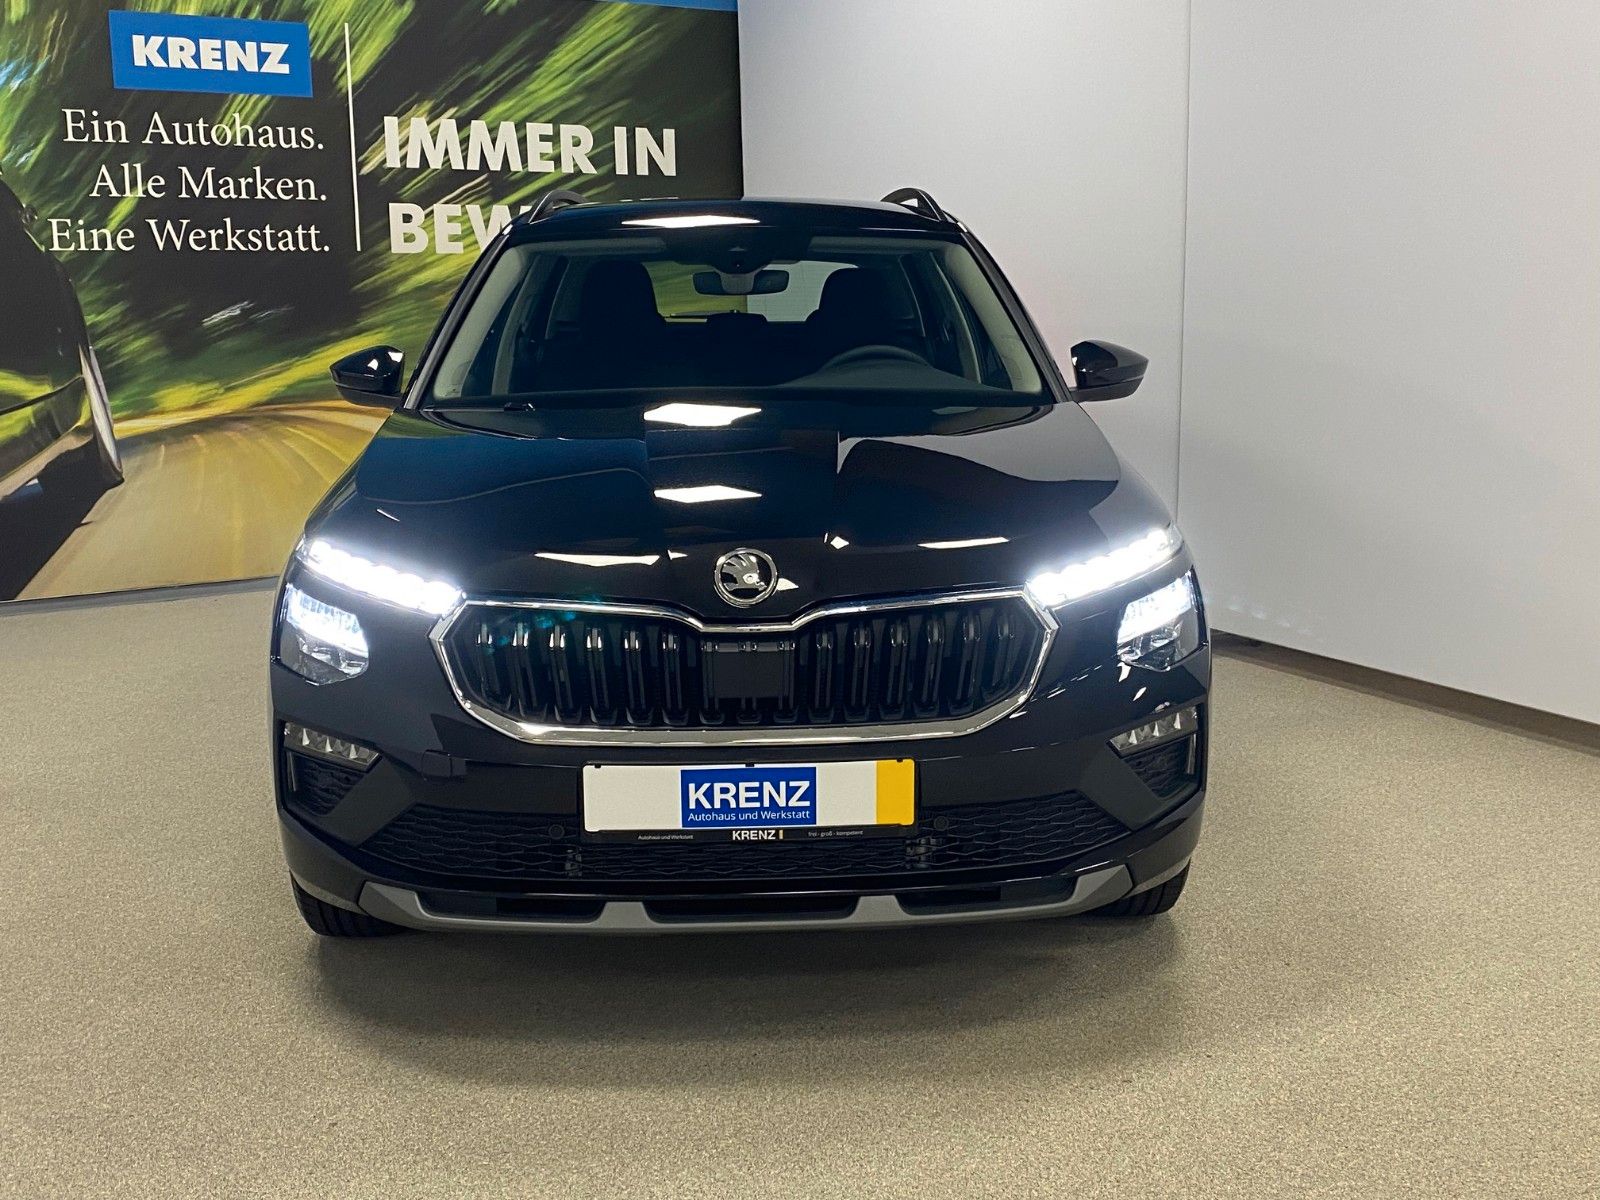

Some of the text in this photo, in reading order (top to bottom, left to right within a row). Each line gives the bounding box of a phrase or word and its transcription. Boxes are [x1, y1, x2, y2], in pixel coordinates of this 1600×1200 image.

[131, 34, 290, 75] KRENZ
[61, 108, 324, 150] Ein Autohaus.
[383, 115, 677, 177] IMMER IN
[89, 163, 327, 201] Alle Marken.
[47, 217, 330, 252] Eine Werkstatt.
[688, 780, 811, 810] KRENZ
[688, 810, 811, 822] Autohaus und Werkstatt
[732, 829, 776, 841] KRENZ
